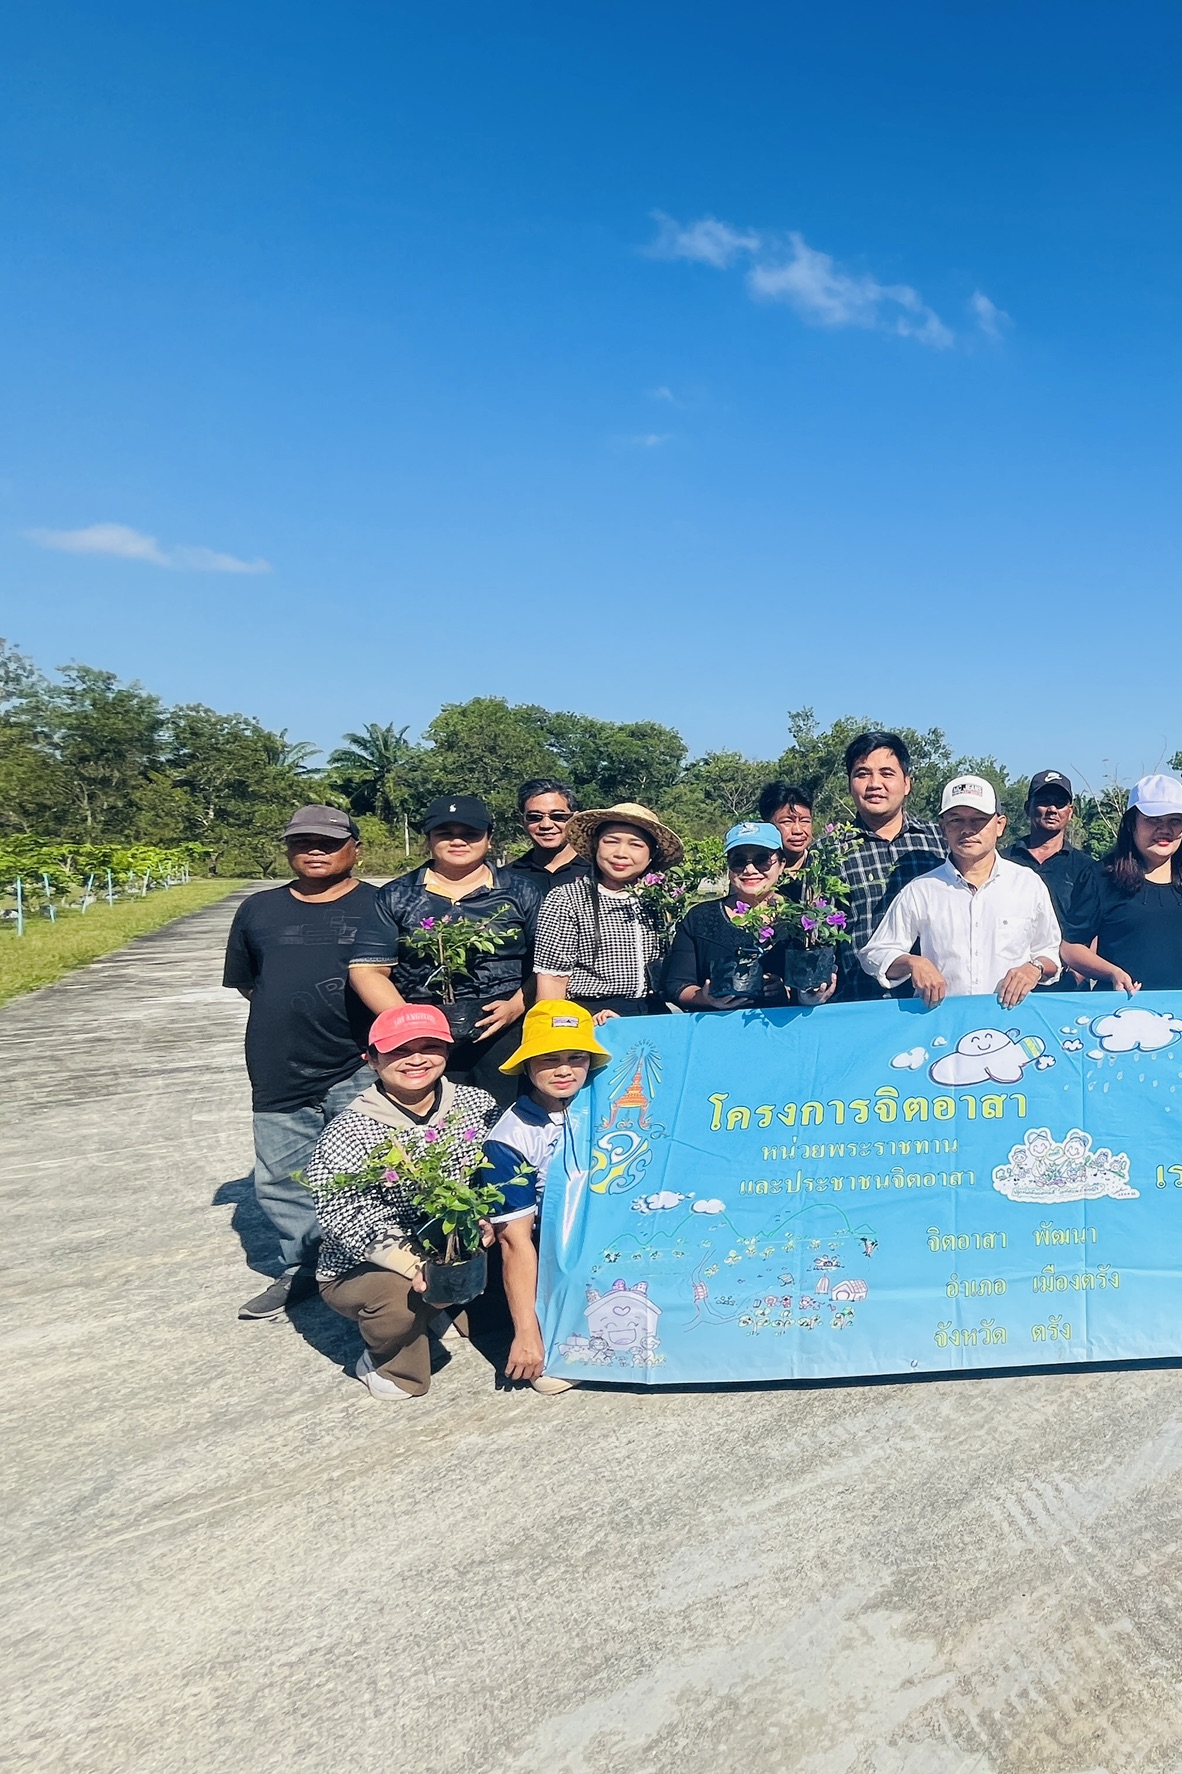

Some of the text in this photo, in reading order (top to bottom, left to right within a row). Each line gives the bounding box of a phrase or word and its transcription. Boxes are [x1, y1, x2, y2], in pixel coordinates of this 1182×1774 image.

[708, 1084, 1028, 1133] โครงการจิตอาสา
[761, 1135, 959, 1162] หน่วยพระราชทาน
[738, 1165, 976, 1197] และประชาชนจิตอาสา
[926, 1221, 1098, 1252] จิตอาสา พัฒนา
[945, 1264, 1120, 1299] อำเภอ เมืองตรัง
[934, 1314, 1072, 1348] จังหวัด ตรัง
